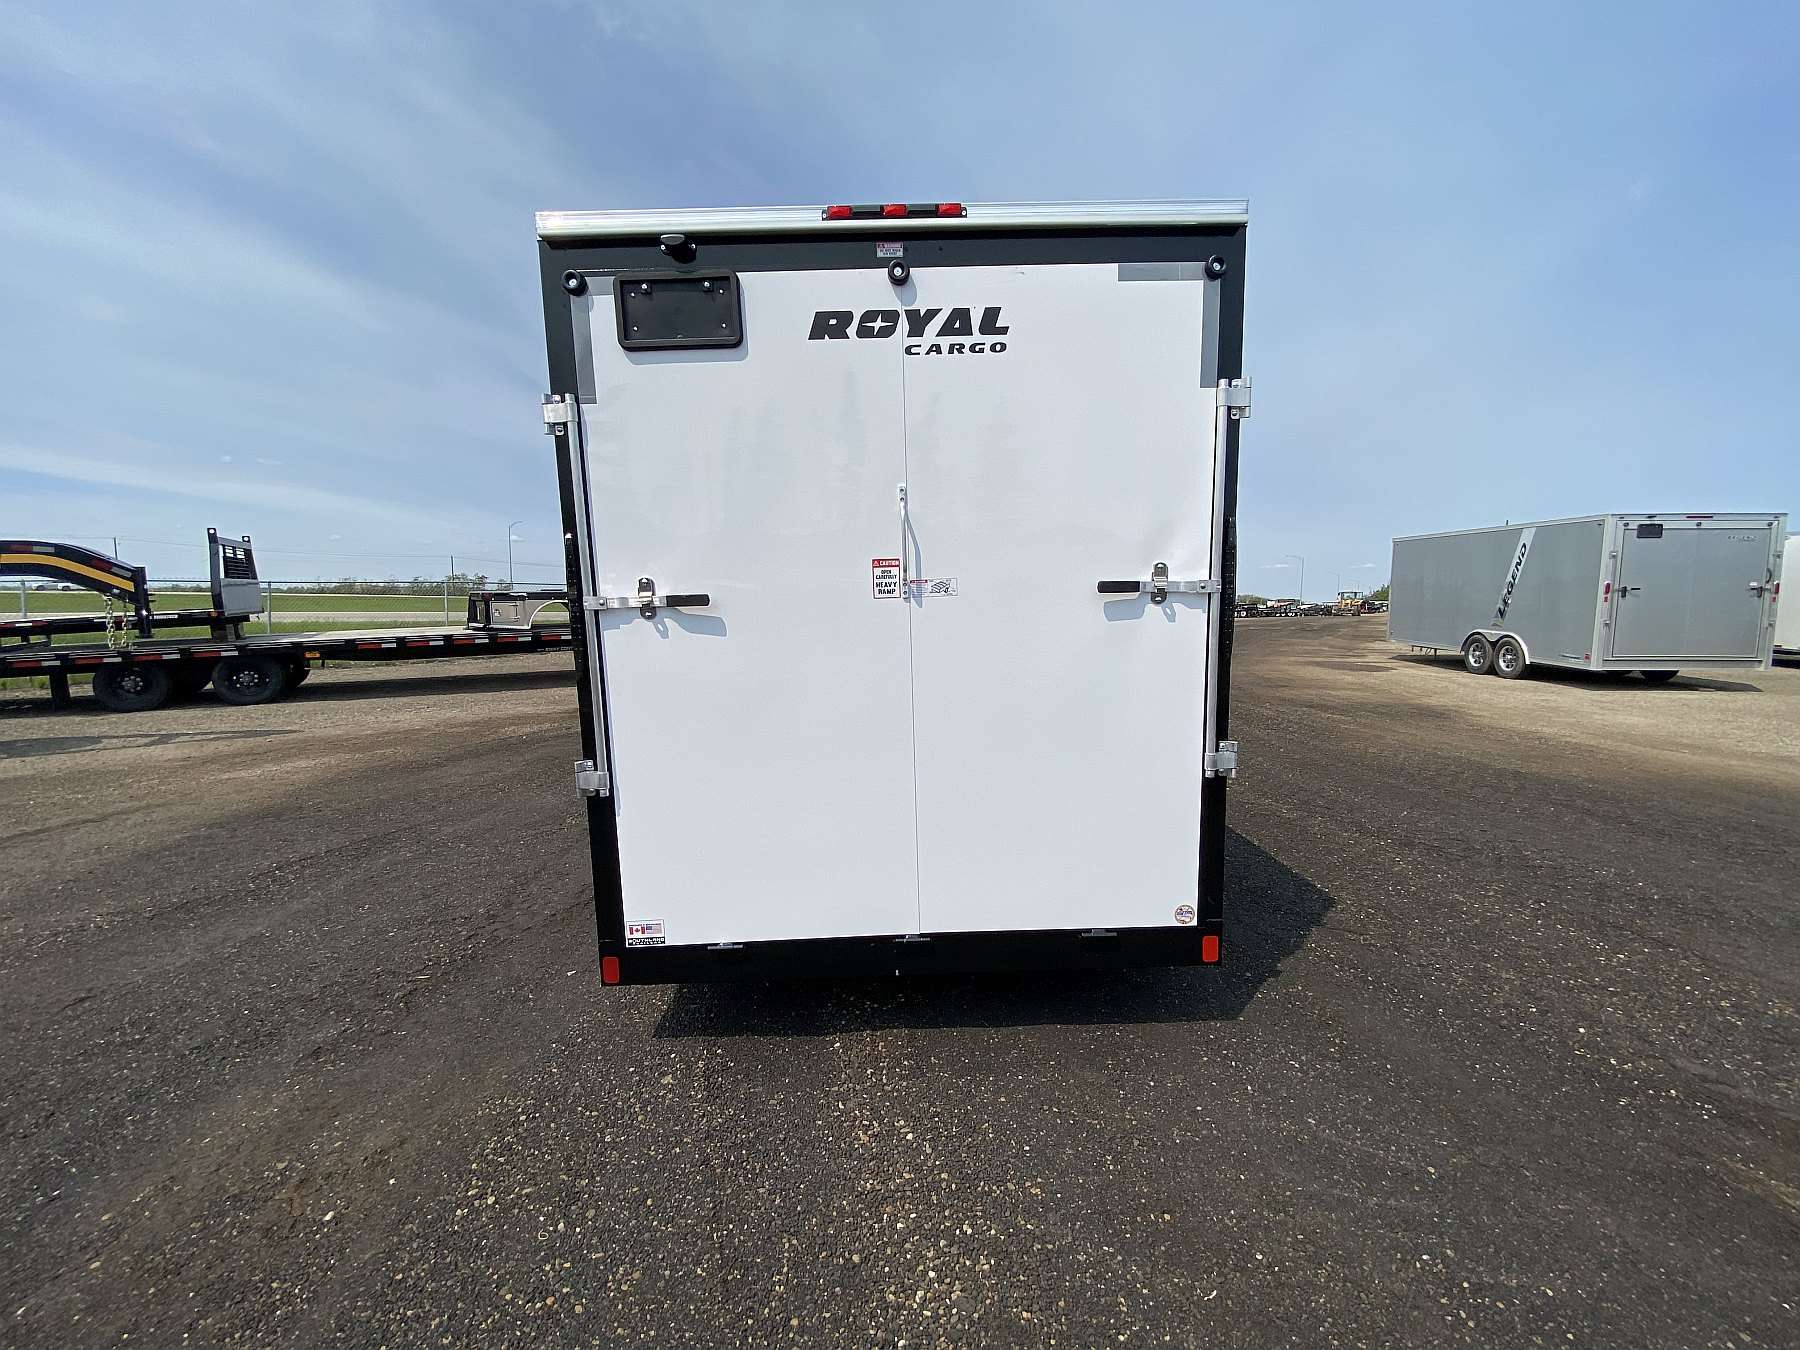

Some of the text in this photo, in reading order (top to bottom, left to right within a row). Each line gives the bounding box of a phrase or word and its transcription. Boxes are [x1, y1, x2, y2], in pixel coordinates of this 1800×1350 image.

[808, 307, 1010, 340] ROYAL
[904, 342, 1007, 356] CARGO
[1498, 542, 1527, 619] LEGEND
